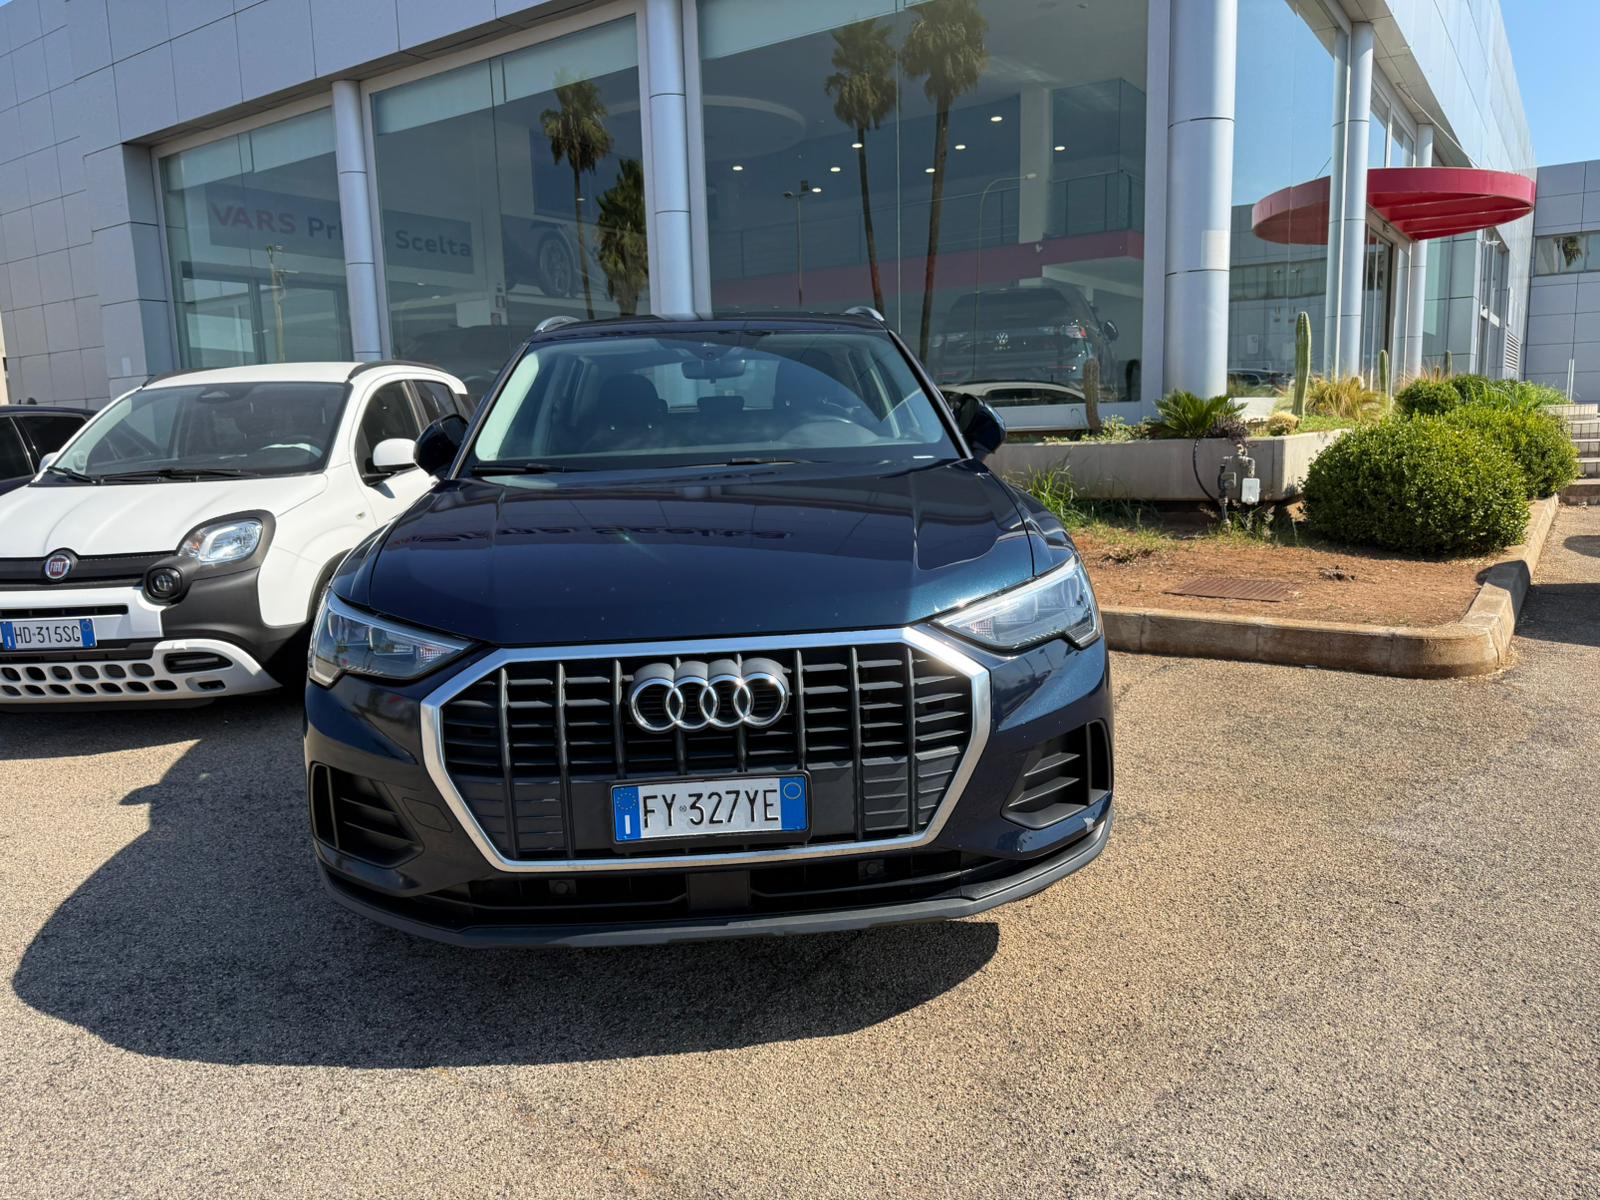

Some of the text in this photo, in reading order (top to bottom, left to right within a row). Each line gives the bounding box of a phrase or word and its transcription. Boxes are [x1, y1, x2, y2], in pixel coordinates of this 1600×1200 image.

[209, 202, 296, 235] VARS
[395, 229, 473, 258] Scelta
[50, 561, 64, 572] FIAT
[14, 625, 80, 643] HD 315SG
[642, 789, 779, 828] FY 327YE
